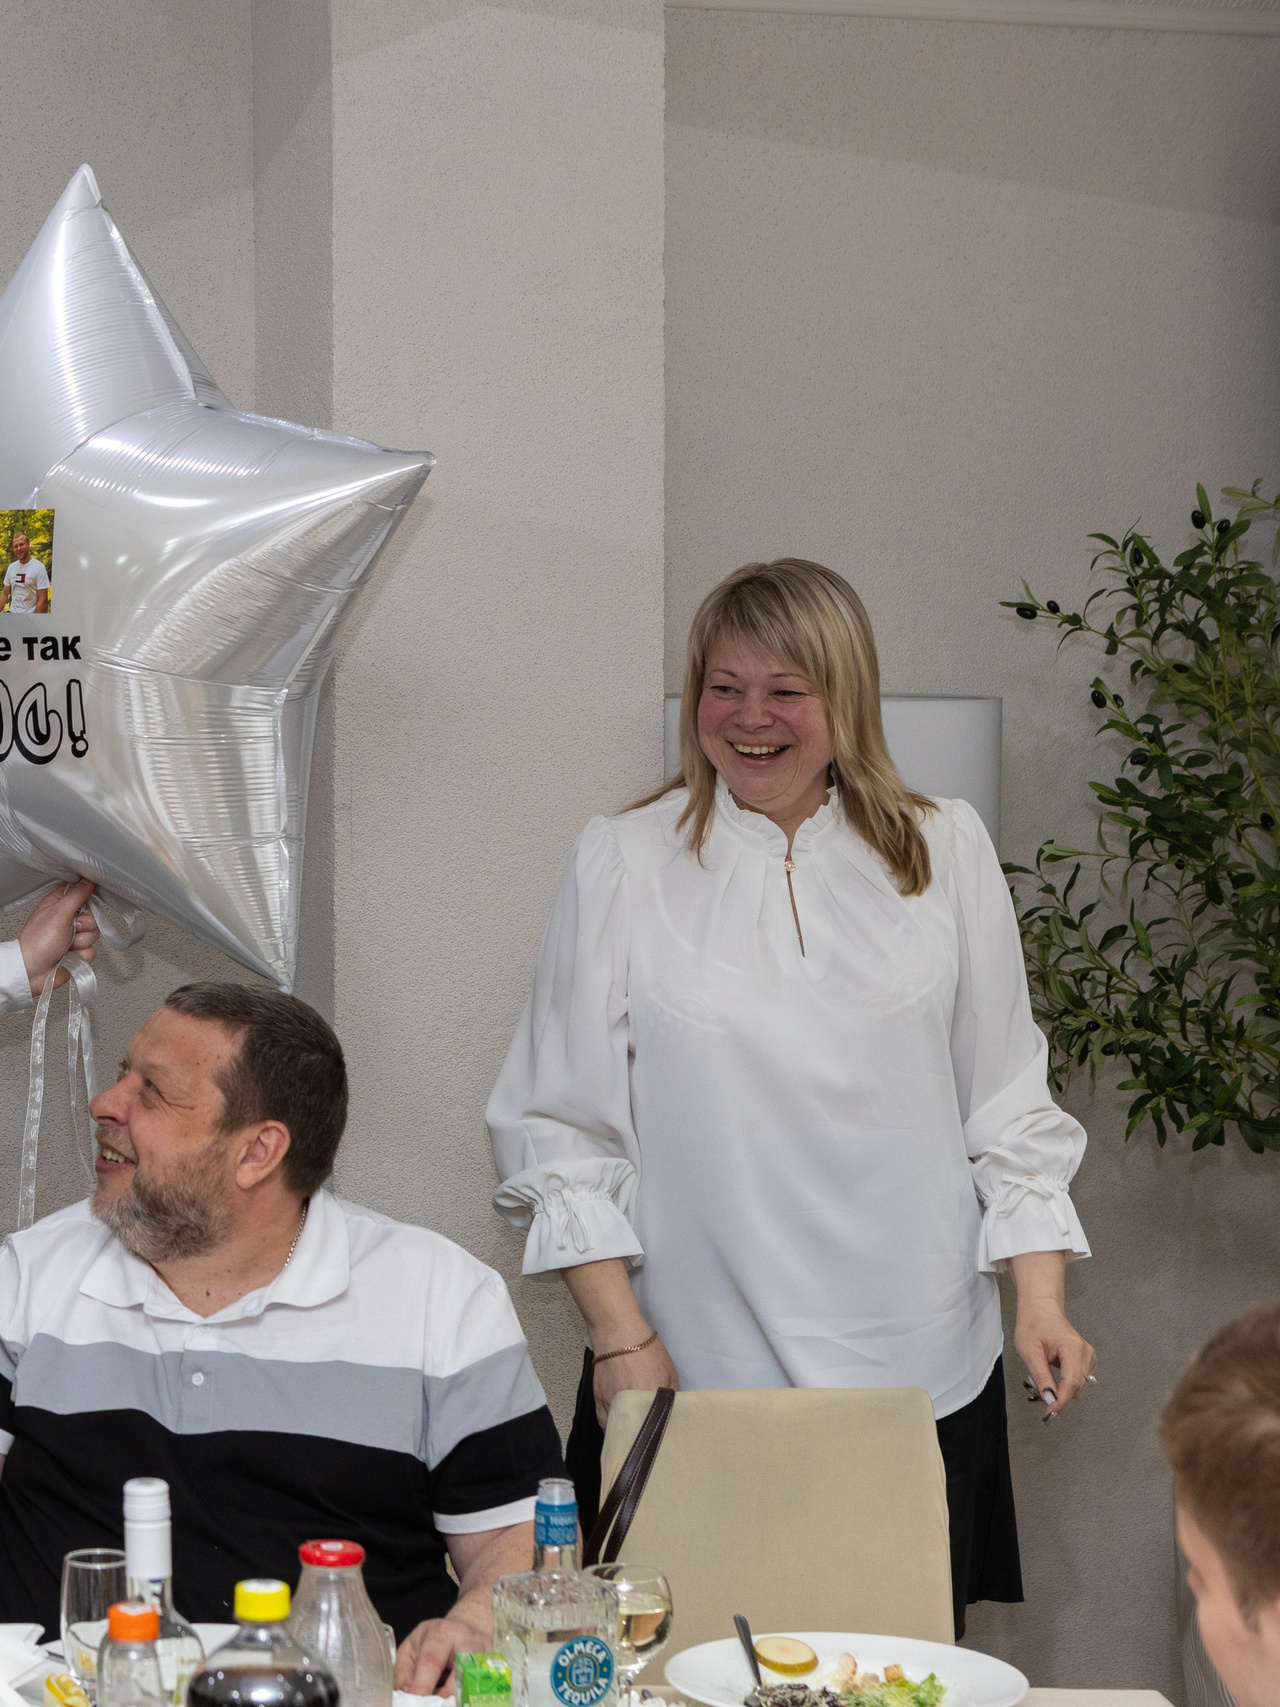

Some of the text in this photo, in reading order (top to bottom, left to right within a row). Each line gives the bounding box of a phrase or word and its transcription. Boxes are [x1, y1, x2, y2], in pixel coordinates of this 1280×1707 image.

[22, 635, 82, 661] так
[558, 1641, 607, 1667] OLMECA
[558, 1678, 609, 1705] TEQUILA
